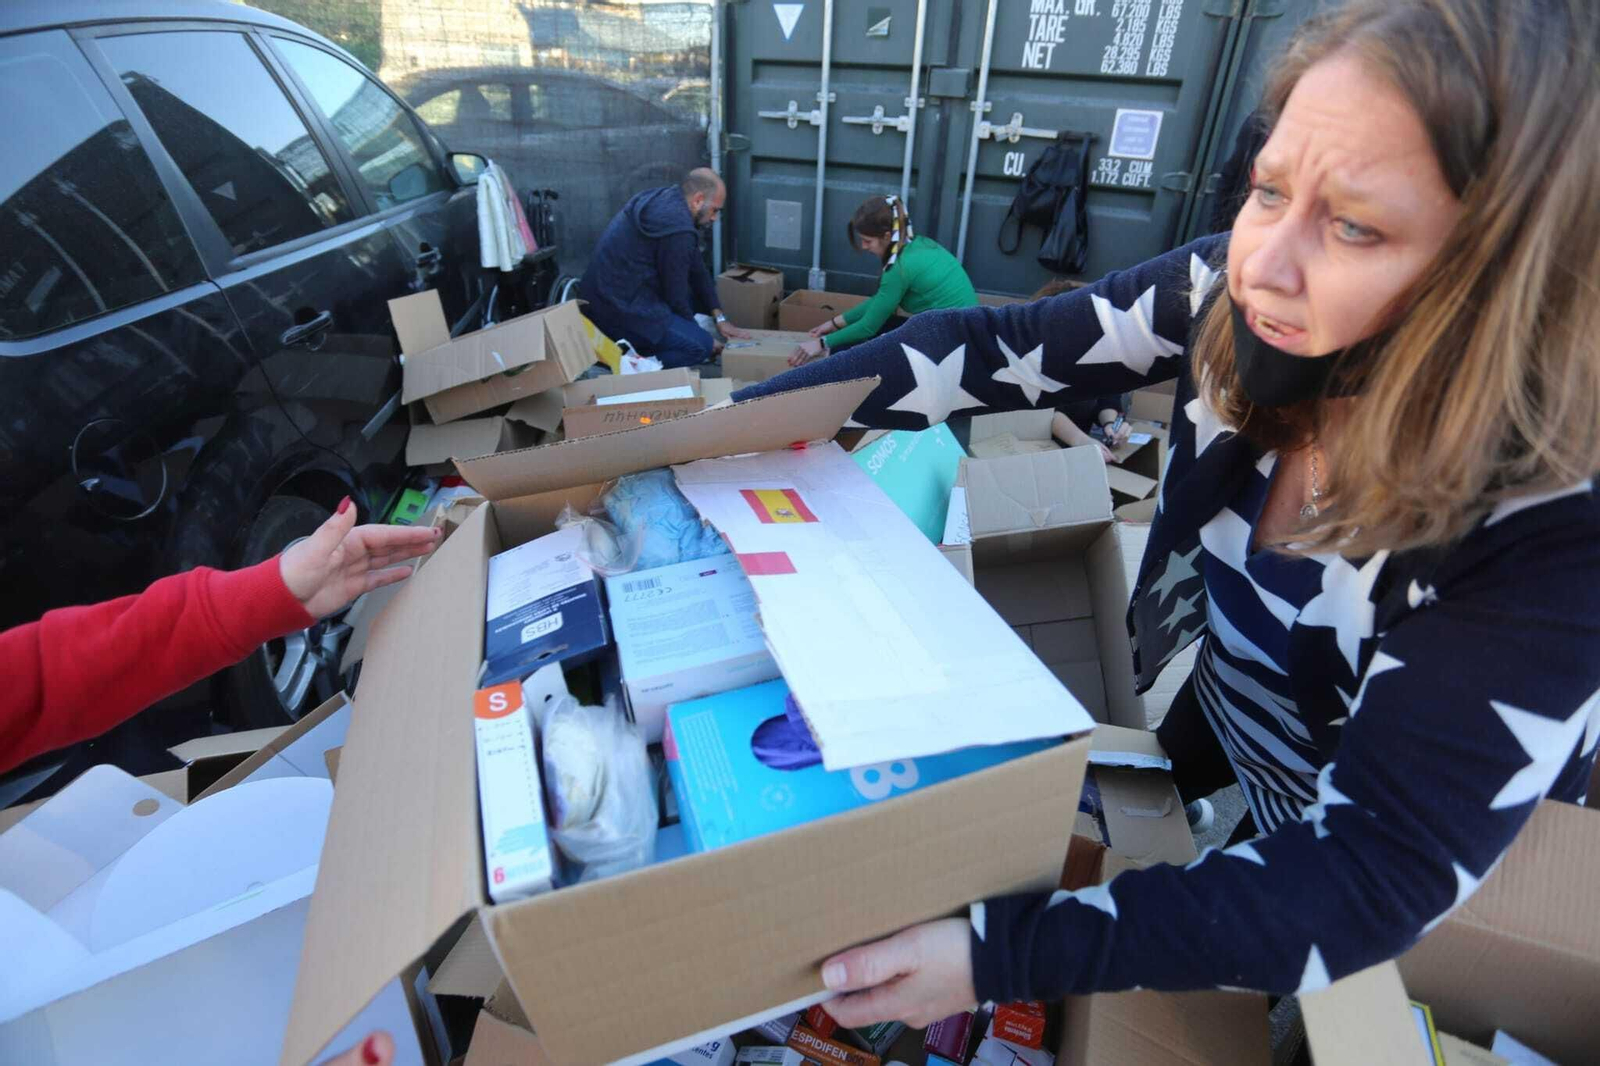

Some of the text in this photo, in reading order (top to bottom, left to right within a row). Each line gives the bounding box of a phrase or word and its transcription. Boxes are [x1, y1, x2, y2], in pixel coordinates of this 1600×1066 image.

[1158, 5, 1182, 20] LBS
[1028, 15, 1179, 43] TARE 2.185 KGS
[1151, 33, 1175, 49] LBS
[1022, 43, 1057, 69] NET
[1148, 47, 1172, 63] KGS
[1100, 60, 1168, 77] 62.380 LBS
[1003, 151, 1027, 177] CU.
[866, 433, 898, 476] SOMOS
[525, 615, 559, 638] HBS
[489, 692, 508, 712] S
[791, 1029, 848, 1061] ESPIDIFEN
